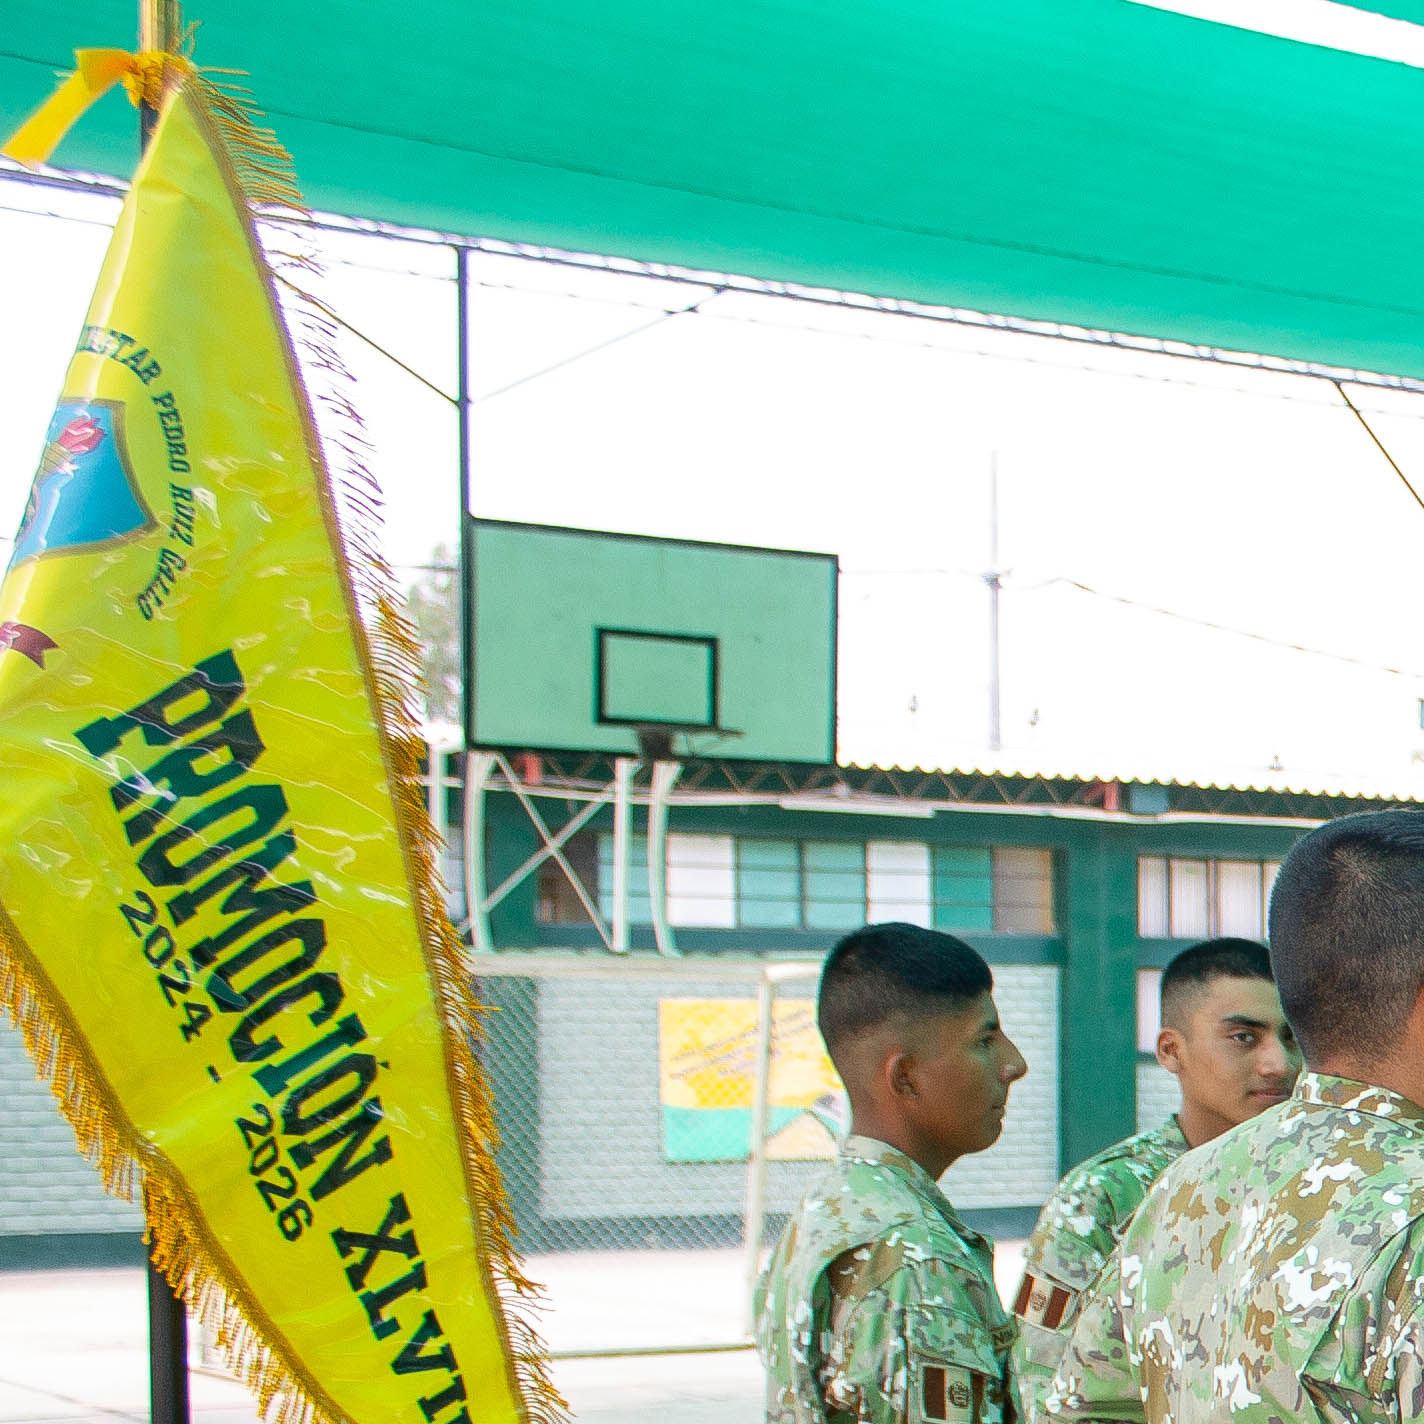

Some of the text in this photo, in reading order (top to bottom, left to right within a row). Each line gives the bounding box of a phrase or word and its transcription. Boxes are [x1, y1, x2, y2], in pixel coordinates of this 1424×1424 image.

[150, 391, 191, 474] PEDRO
[168, 482, 194, 547] RUIZ
[135, 547, 187, 622] GALLO
[72, 647, 393, 1203] PROMOCIÓN
[117, 889, 212, 1043] 2024
[233, 1102, 313, 1242] 2026
